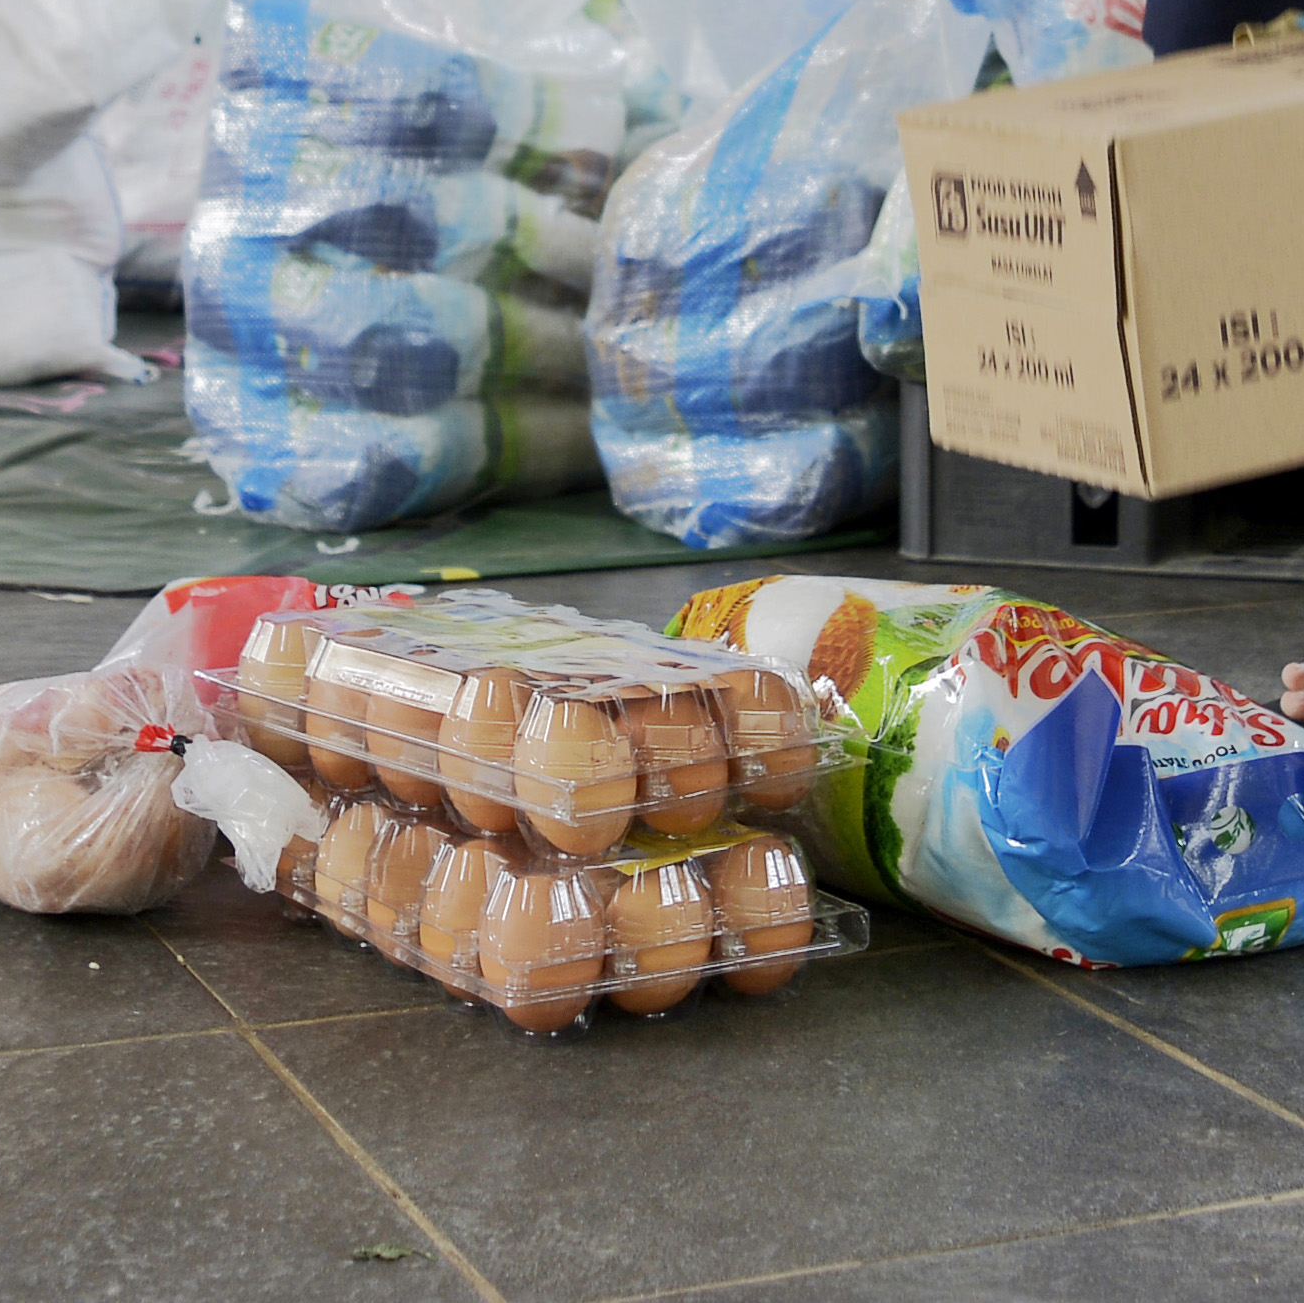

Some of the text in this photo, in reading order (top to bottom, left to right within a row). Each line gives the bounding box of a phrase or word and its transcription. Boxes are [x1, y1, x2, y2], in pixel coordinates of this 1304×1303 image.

[1219, 306, 1261, 349] ISI
[1161, 361, 1201, 402] 24
[1241, 337, 1304, 384] 200
